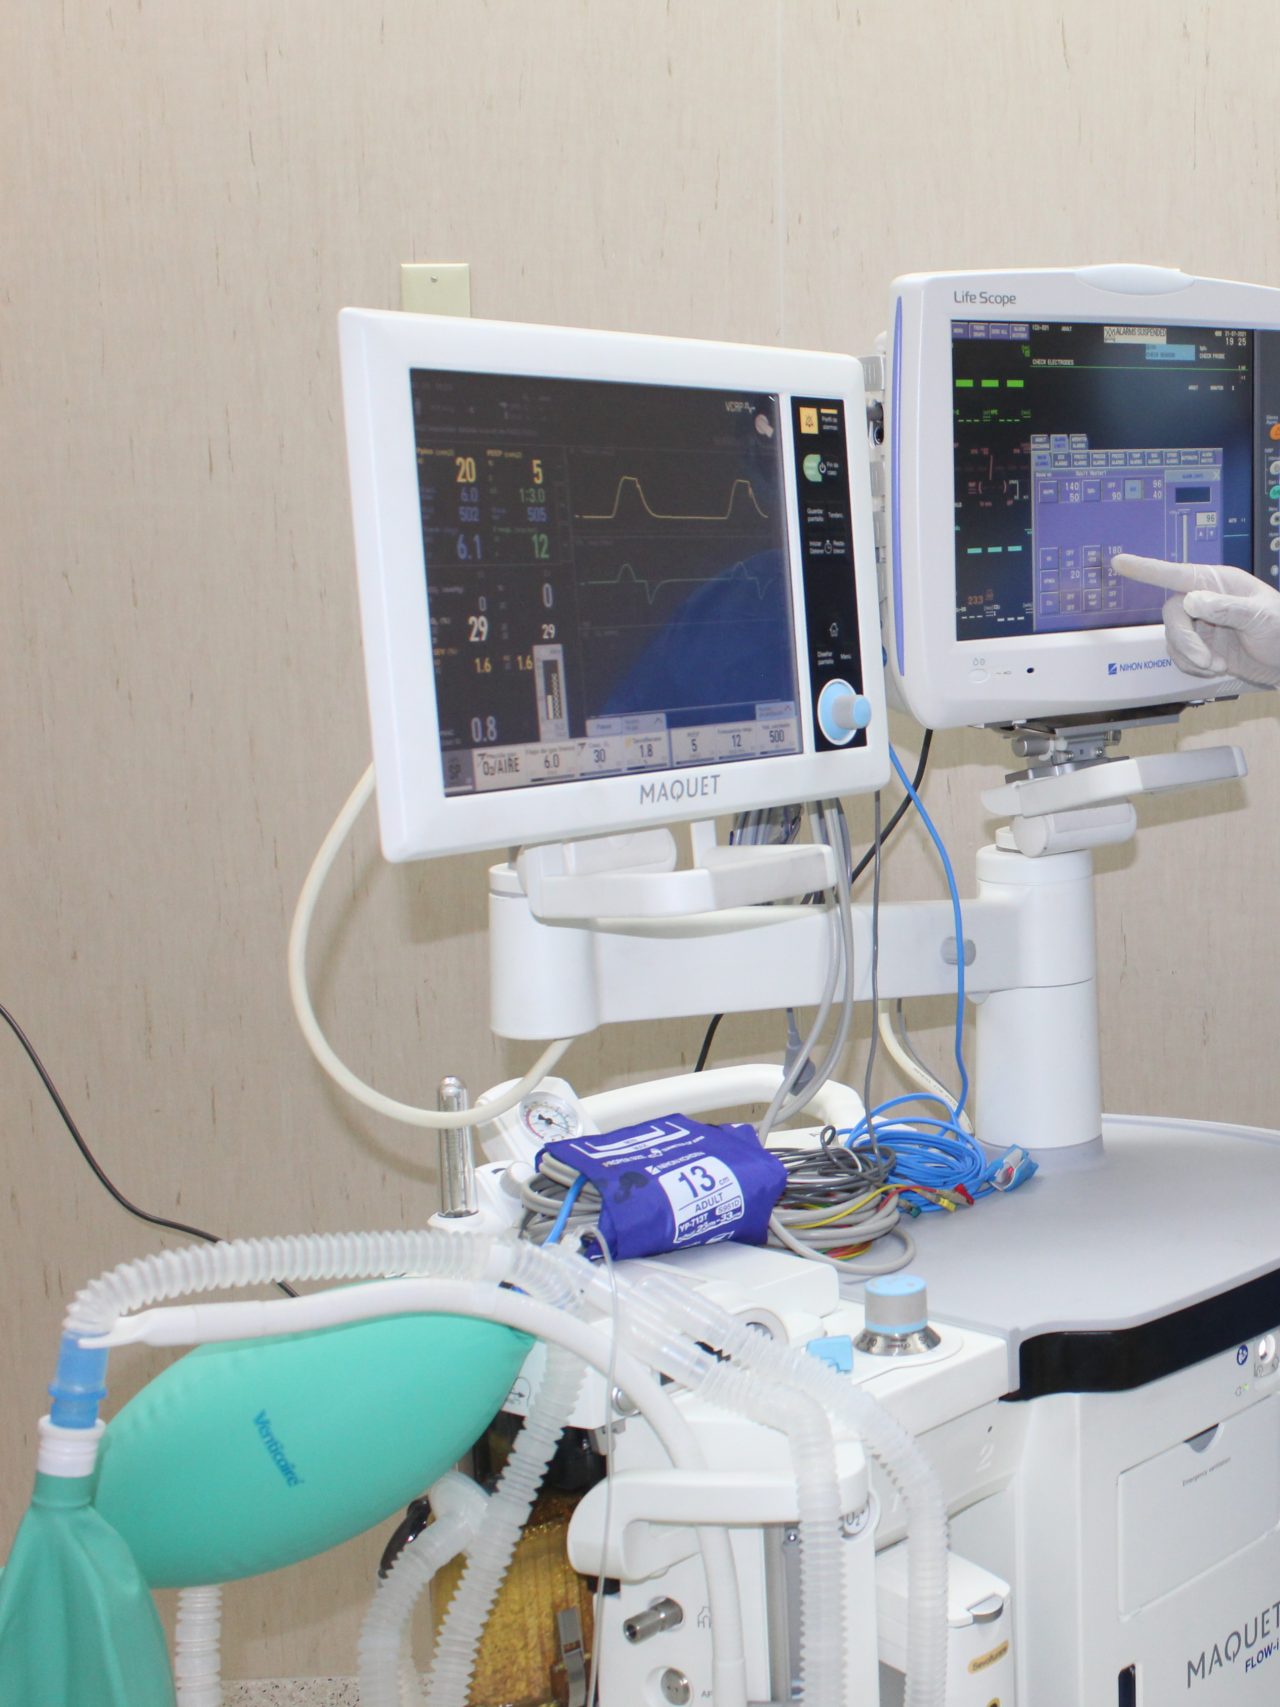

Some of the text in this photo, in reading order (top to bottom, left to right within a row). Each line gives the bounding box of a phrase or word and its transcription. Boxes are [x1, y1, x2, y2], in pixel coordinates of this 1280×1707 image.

[953, 291, 1017, 307] Life Scope
[456, 457, 476, 483] 20
[532, 459, 543, 485] 5
[1206, 514, 1215, 522] 96
[457, 534, 482, 560] 6.1
[532, 534, 550, 559] 12
[543, 583, 553, 608] 0
[468, 616, 489, 642] 29
[541, 624, 556, 640] 29
[474, 657, 492, 673] 1.6
[517, 655, 533, 671] 1.6
[1119, 658, 1172, 672] NIHON KOHDEN
[471, 716, 498, 743] 0.8
[769, 730, 785, 743] 500
[691, 739, 698, 752] 5
[732, 734, 742, 748] 12
[544, 753, 560, 769] 6.0
[594, 748, 606, 763] 30
[639, 774, 721, 805] MAQUET
[678, 1165, 716, 1198] 13
[718, 1176, 730, 1186] cm
[695, 1192, 724, 1213] ADULT
[1244, 1638, 1280, 1673] FLOW-i
